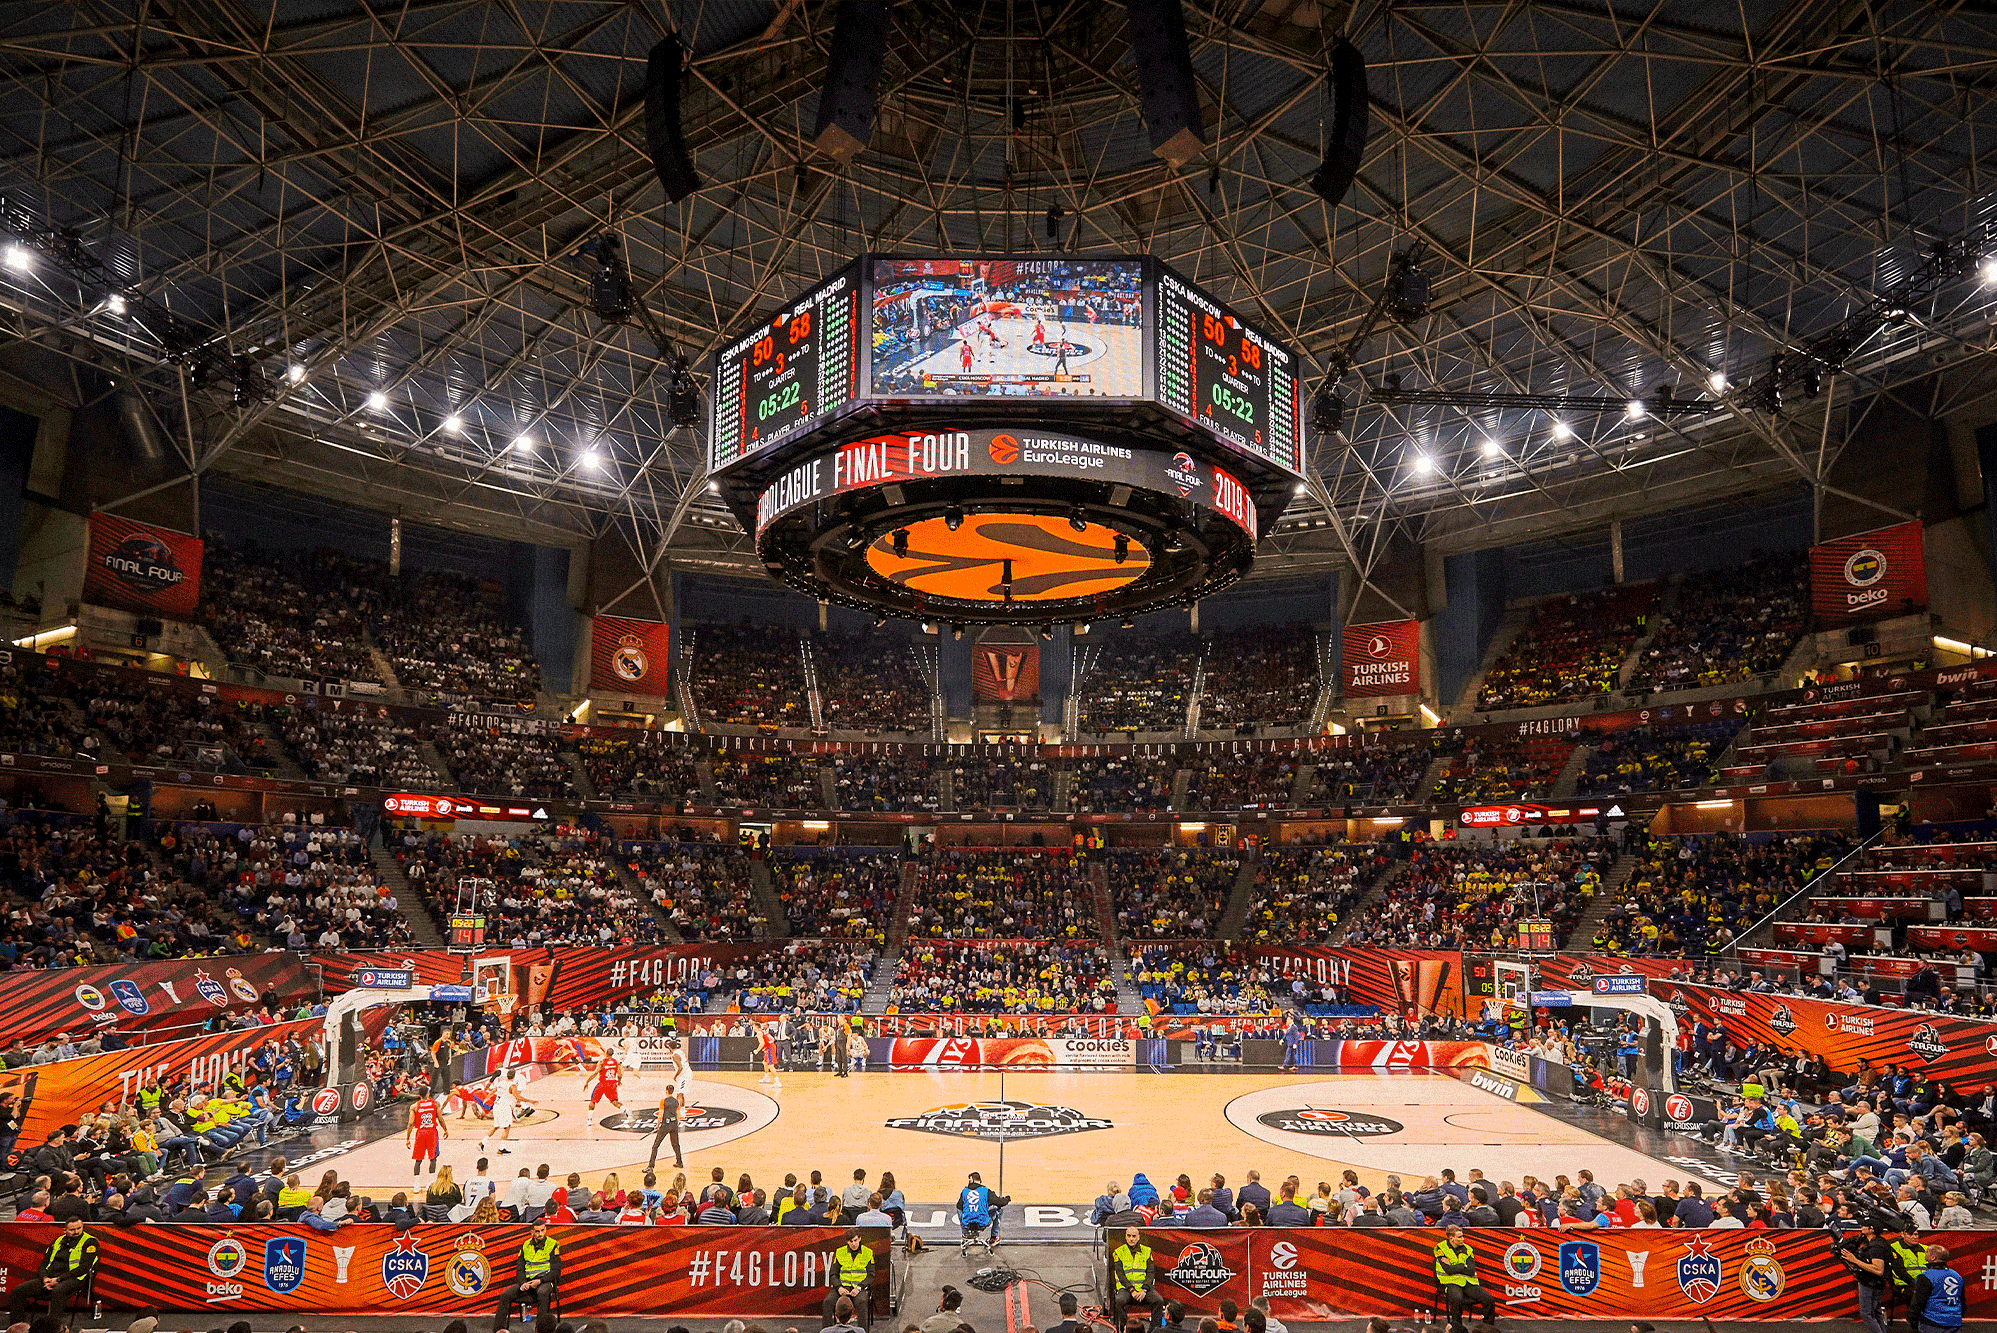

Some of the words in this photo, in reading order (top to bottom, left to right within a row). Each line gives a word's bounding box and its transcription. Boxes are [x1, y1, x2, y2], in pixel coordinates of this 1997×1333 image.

[794, 298, 814, 317] REAL
[815, 277, 846, 303] MADRID
[1163, 275, 1186, 297] CSKA
[1186, 289, 1221, 319] MOSCOW
[789, 312, 811, 344] 58
[1204, 313, 1225, 346] 50
[721, 344, 739, 363] CSKA
[739, 325, 770, 353] MOSCOW
[753, 336, 773, 366] 50
[801, 343, 809, 355] TO
[1205, 345, 1213, 357] TO
[1245, 328, 1264, 347] REAL
[1264, 340, 1288, 364] MADRID
[1241, 338, 1261, 369] 58
[775, 353, 785, 374] 3
[1228, 354, 1237, 376] 3
[754, 372, 761, 383] TO
[769, 367, 796, 389] QUARTER
[1222, 372, 1249, 394] QUARTER
[1253, 375, 1260, 386] TO
[759, 382, 800, 420] 05:22
[1213, 384, 1254, 424] 05:22
[1205, 404, 1212, 417] 4
[752, 426, 758, 440] 4
[768, 424, 790, 442] PLAYER
[1223, 427, 1246, 445] PLAYER
[1255, 429, 1261, 444] 5
[1023, 439, 1078, 451] TURKISH
[1080, 441, 1132, 459] AIRLINES
[834, 441, 893, 488] FINAL
[908, 432, 969, 474] FOUR
[1023, 450, 1104, 469] EuroLeague
[1215, 472, 1242, 521] 2019
[106, 555, 144, 575] FINAL
[149, 566, 183, 582] FOUR
[1847, 589, 1888, 605] beko
[135, 636, 143, 646] 6
[1866, 645, 1879, 655] 10
[1352, 661, 1410, 676] TURKISH
[1352, 673, 1410, 687] AIRLINES
[1937, 667, 1979, 685] bwin
[303, 680, 314, 693] R
[329, 685, 342, 697] M
[1823, 682, 1861, 694] TURKISH
[1379, 706, 1386, 715] 9
[1519, 717, 1580, 736] #F4GLORY
[642, 730, 689, 747] 2019
[709, 735, 793, 752] TURKISH
[812, 740, 903, 755] AIRLINES
[1132, 743, 1176, 756] FOUR
[400, 799, 429, 807] TURKISH
[452, 919, 474, 928] 05:22
[1530, 924, 1551, 932] 05:22
[458, 929, 472, 943] 14
[1537, 935, 1550, 947] 14
[377, 972, 407, 980] TURKISH
[1473, 967, 1486, 978] 50
[201, 984, 222, 993] CSKA
[1720, 998, 1746, 1008] TURKISH
[90, 1011, 117, 1022] beko
[1719, 1005, 1746, 1016] AIRLINES
[1840, 1015, 1874, 1027] TURKISH
[1840, 1024, 1875, 1036] AIRLINES
[618, 1037, 682, 1049] Cokies
[1066, 1039, 1130, 1052] Cookies
[1495, 1047, 1526, 1067] Cookies
[1471, 1071, 1514, 1098] bwin
[318, 1091, 333, 1112] 7
[324, 1092, 338, 1112] DAYS
[356, 1086, 363, 1106] 7
[1636, 1093, 1644, 1112] 7
[1670, 1099, 1684, 1119] 7
[1680, 1100, 1689, 1118] DAYS
[421, 1113, 433, 1124] 22
[469, 1194, 477, 1207] 7
[969, 1204, 980, 1213] TV
[269, 1265, 299, 1275] ANADOLU
[388, 1258, 423, 1271] CSKA
[688, 1250, 834, 1288] #F4GLORY
[1682, 1262, 1716, 1275] CSKA
[273, 1272, 295, 1281] EFES
[1262, 1271, 1307, 1280] TURKISH
[1564, 1269, 1595, 1279] ANADOLU
[1569, 1276, 1591, 1285] EFES
[206, 1281, 243, 1296] beko
[1262, 1280, 1307, 1289] AIRLINES
[1505, 1283, 1542, 1297] beko
[1262, 1289, 1308, 1298] EuroLeague
